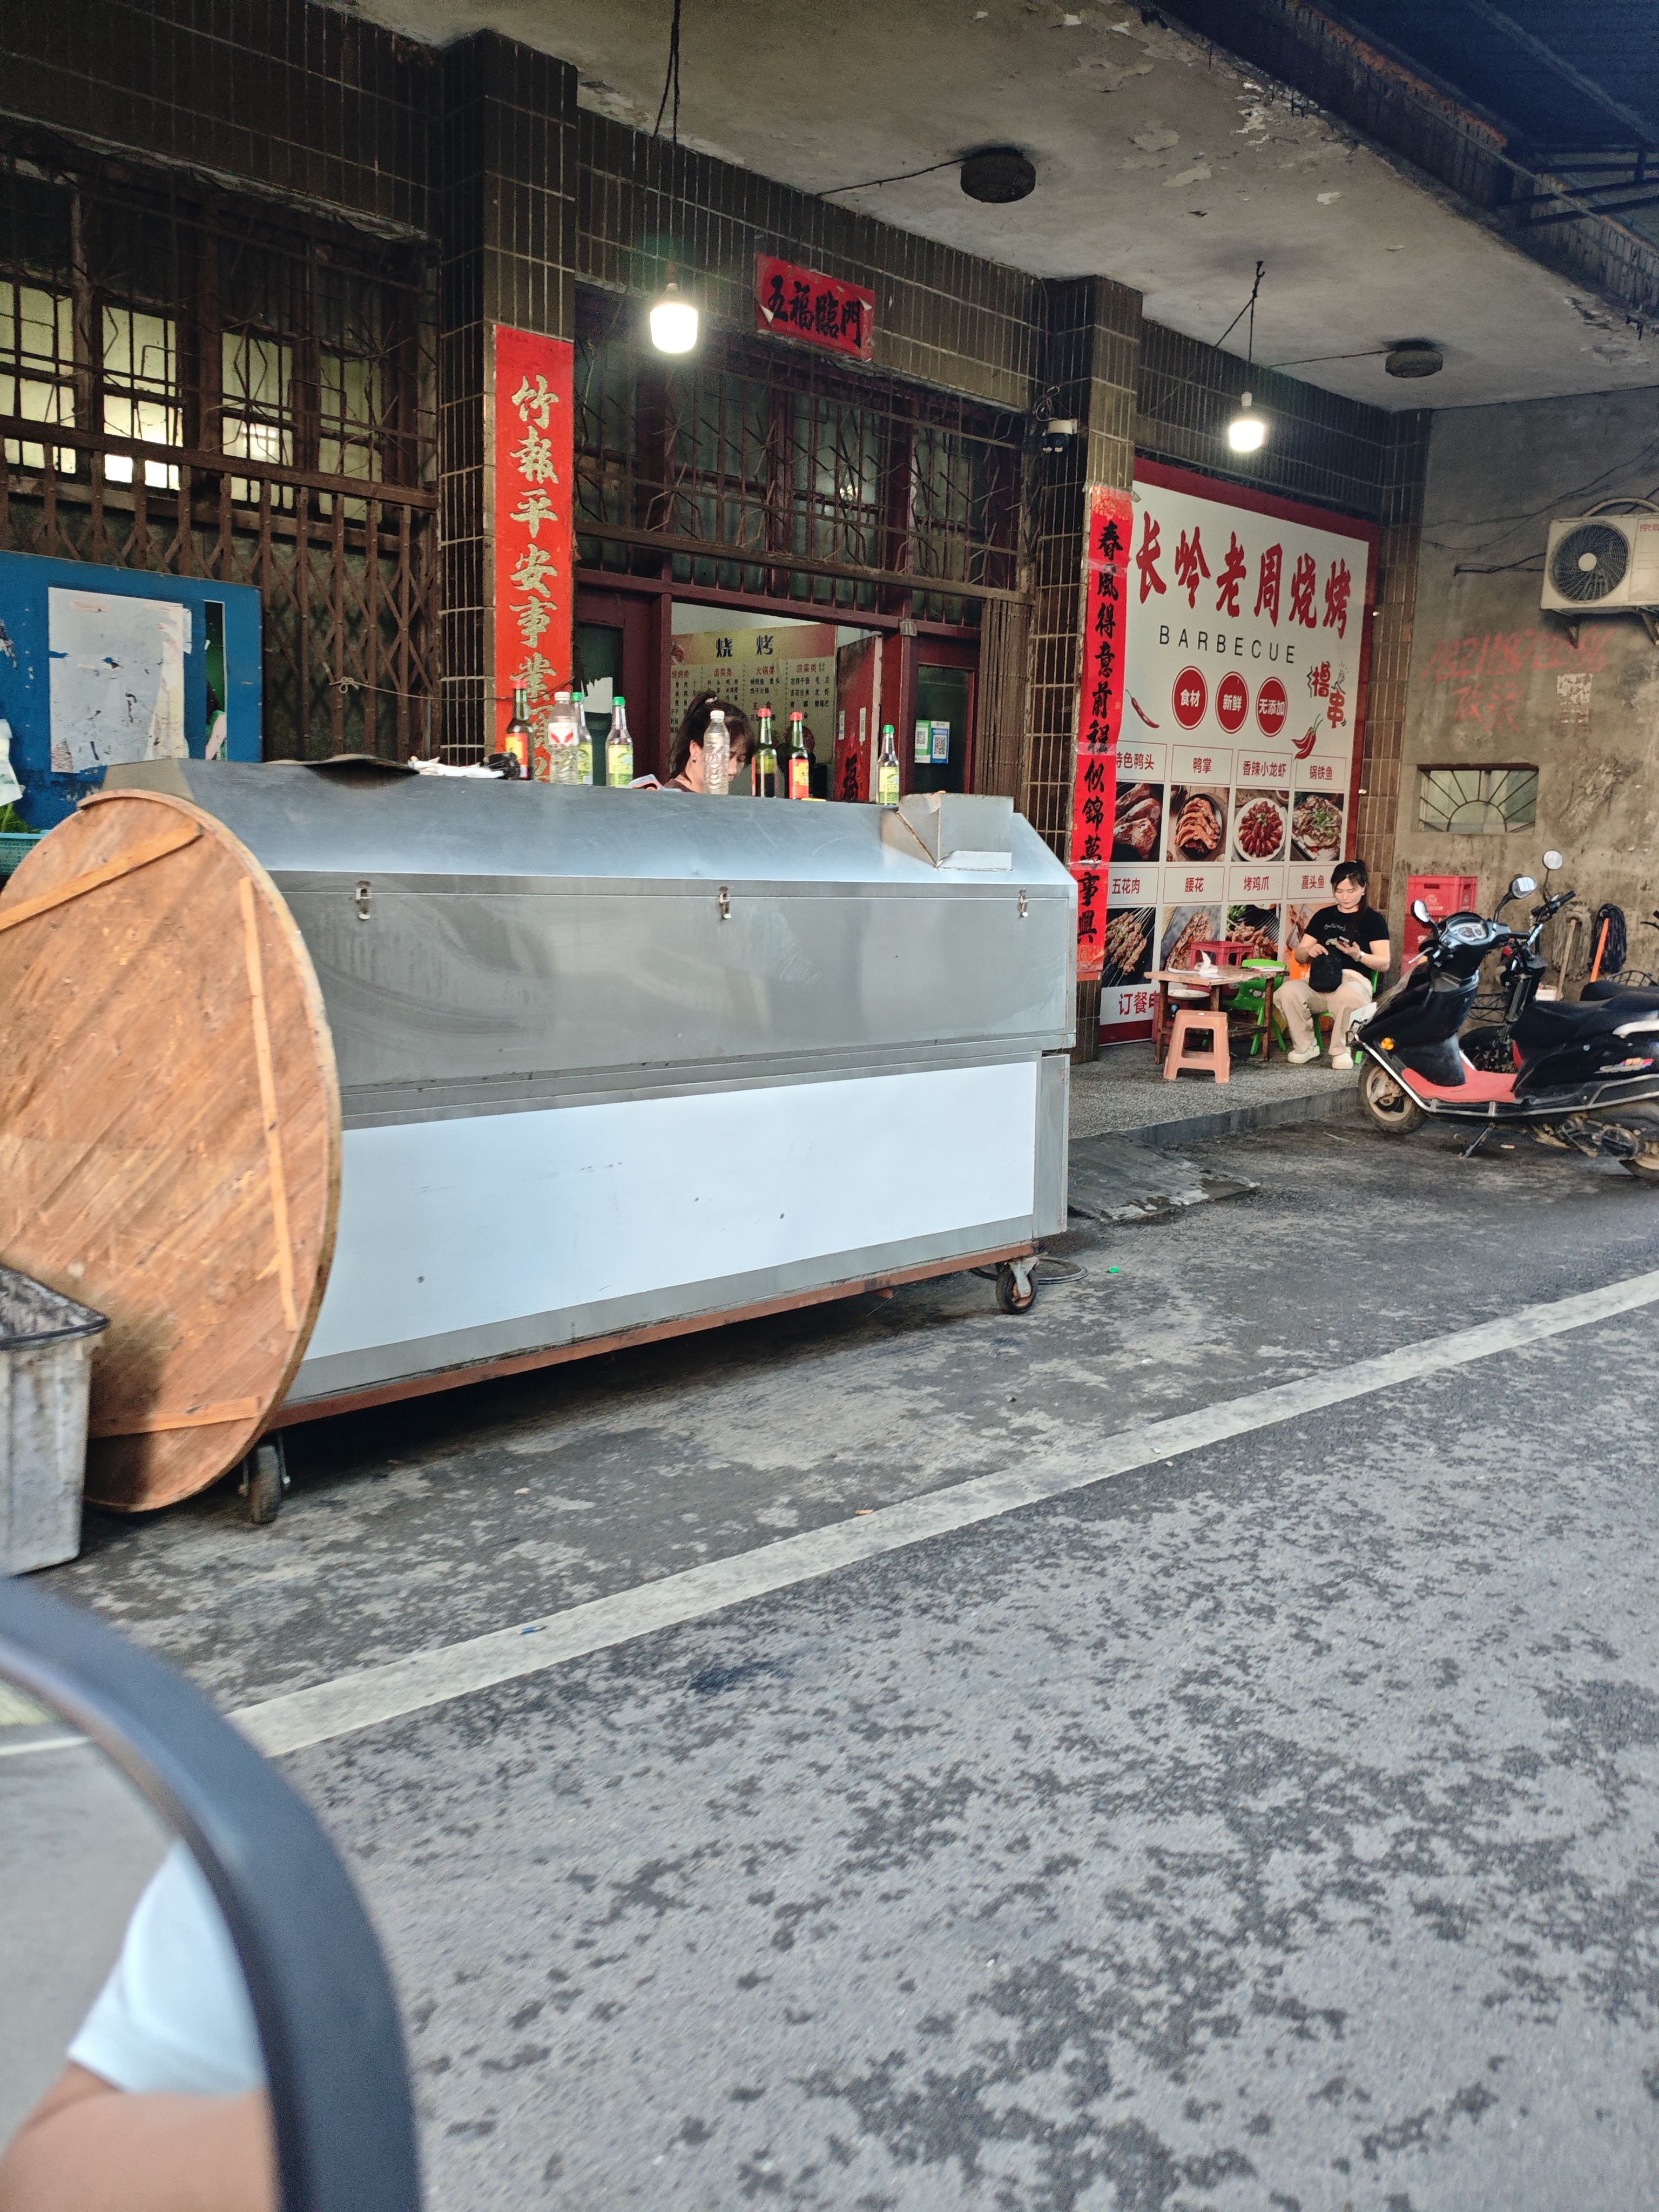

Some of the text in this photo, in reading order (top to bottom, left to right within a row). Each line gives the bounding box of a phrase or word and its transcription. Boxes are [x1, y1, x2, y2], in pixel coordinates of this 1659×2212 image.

[509, 374, 558, 783] 竹報平安事業
[1135, 510, 1351, 640] 长岭老周烧烤
[716, 634, 774, 658] 烧烤
[1159, 625, 1296, 664] BARBECUE
[1181, 689, 1200, 707] 食材
[1223, 694, 1242, 712] 新鲜
[1259, 699, 1284, 716] 无添加
[1192, 758, 1212, 774] 鸭掌
[1243, 760, 1287, 778] 香辣小龙虾
[1310, 765, 1333, 781] 锅铁鱼
[1111, 878, 1141, 895] 五花肉
[1184, 877, 1205, 893] 腰花
[1243, 875, 1270, 892] 烤鸡爪
[1301, 874, 1325, 890] 喜头鱼
